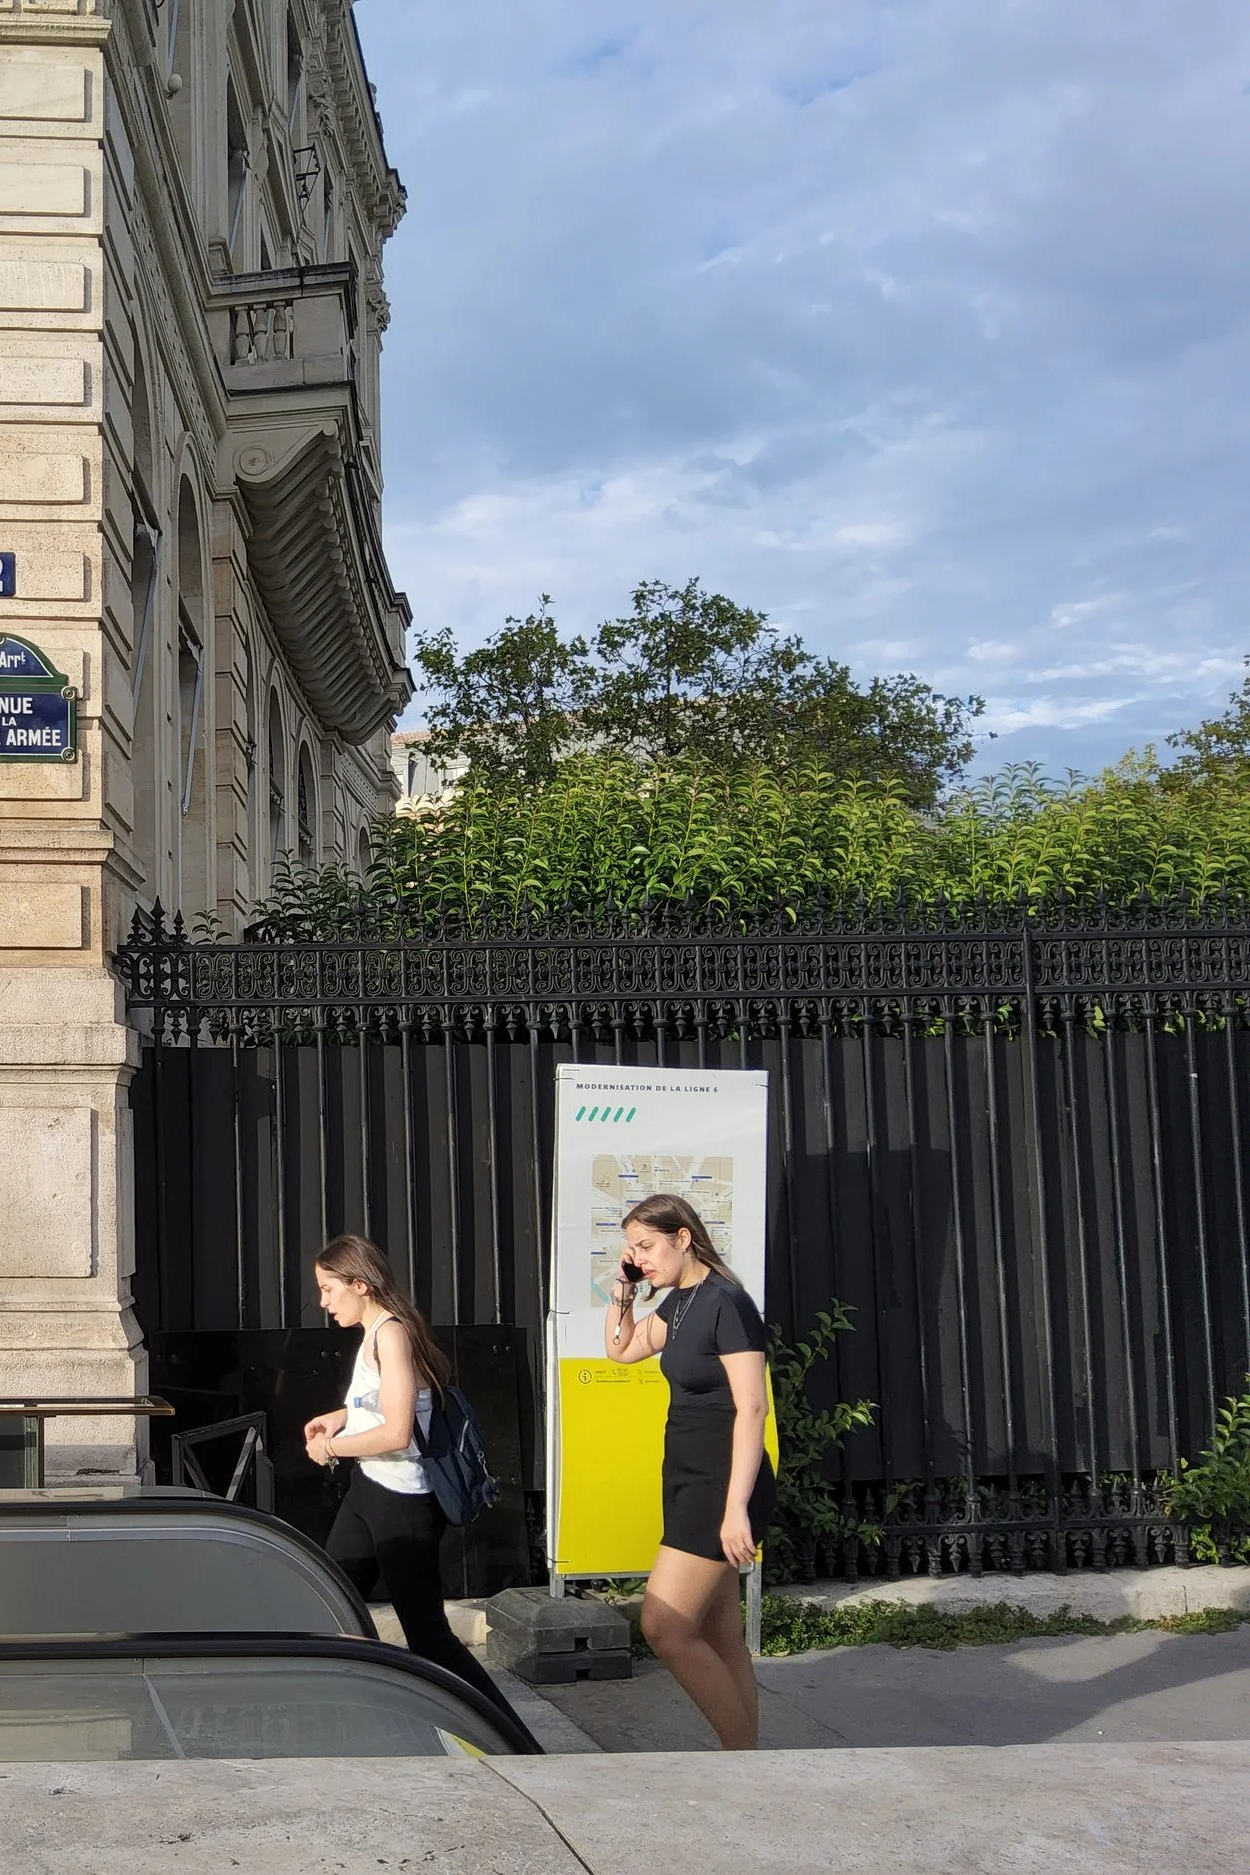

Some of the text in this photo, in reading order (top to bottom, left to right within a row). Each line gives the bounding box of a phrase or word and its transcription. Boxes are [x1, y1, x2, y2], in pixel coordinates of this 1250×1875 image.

[2, 716, 18, 726] LA
[6, 726, 62, 747] ARMÉE
[576, 1083, 652, 1092] MODERNISATION
[670, 1085, 681, 1093] LA
[684, 1085, 710, 1093] LIGNE
